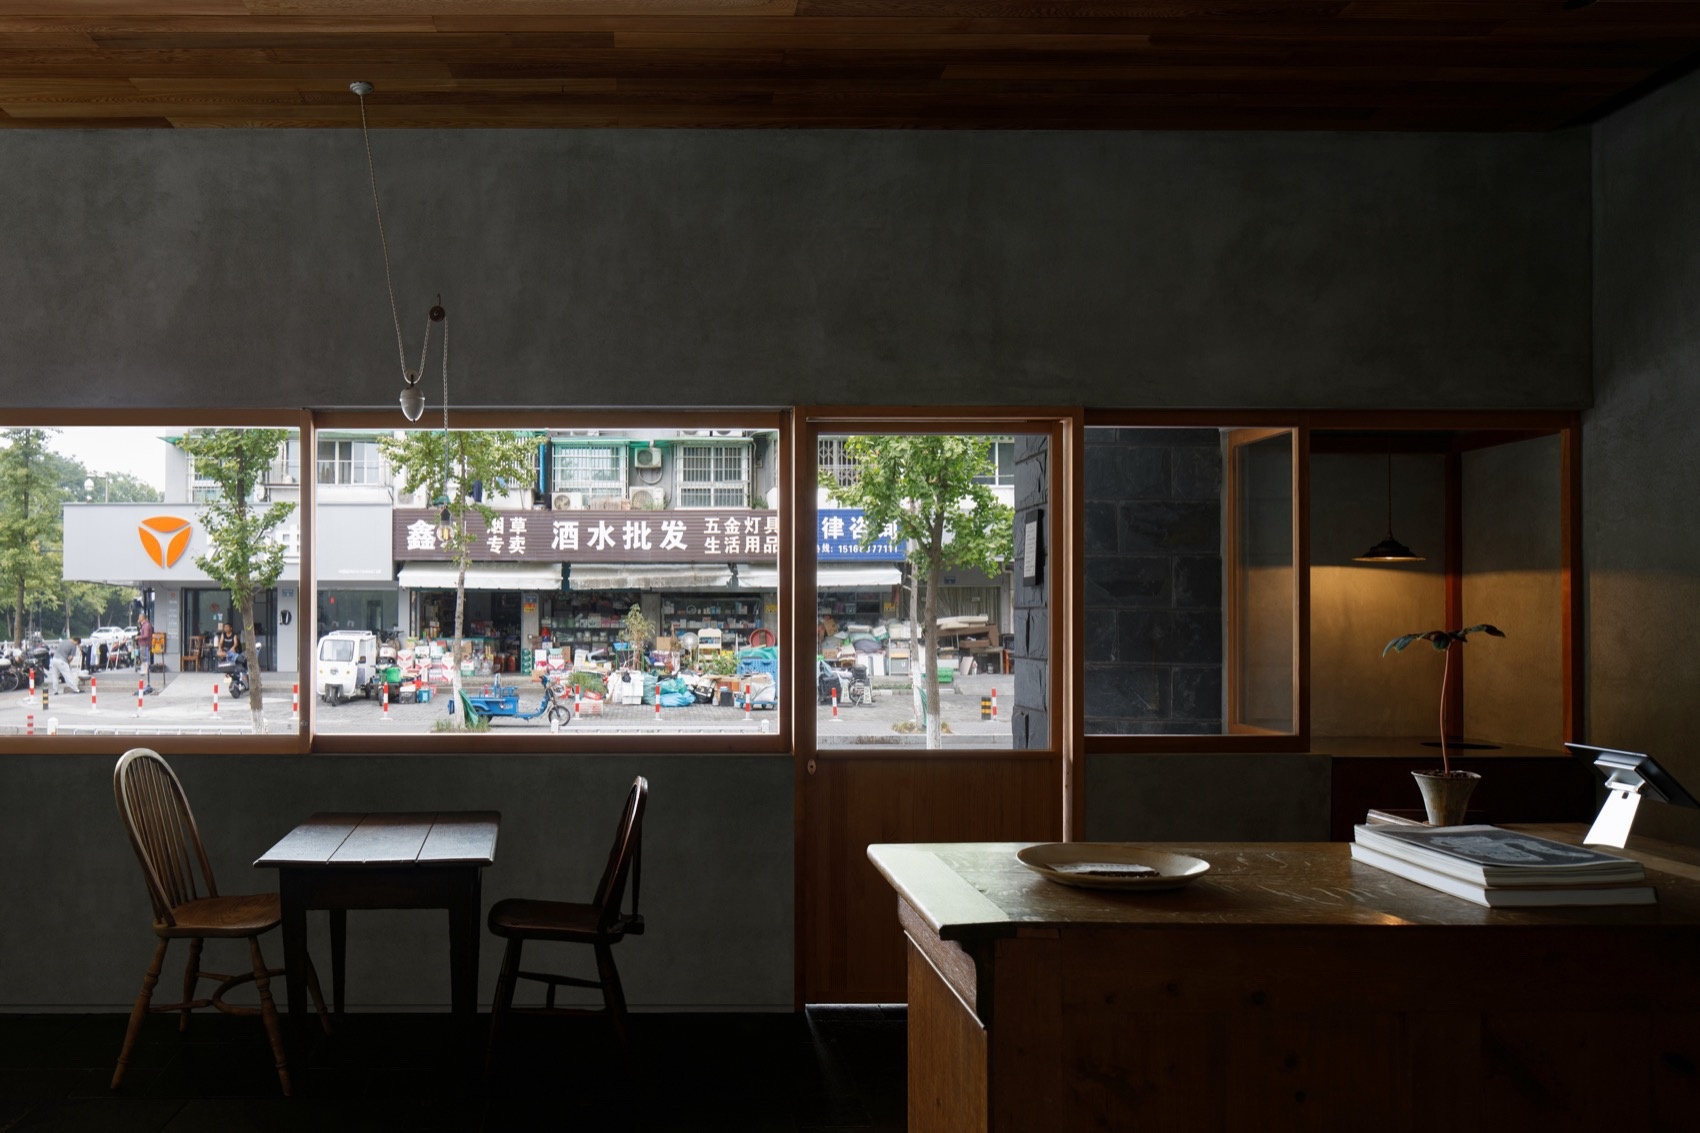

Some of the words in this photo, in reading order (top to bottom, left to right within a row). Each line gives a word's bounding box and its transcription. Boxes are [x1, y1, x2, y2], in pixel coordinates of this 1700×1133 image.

[703, 516, 778, 535] 五金灯具
[486, 535, 526, 554] 专卖
[551, 520, 688, 551] 酒水批发
[704, 536, 778, 554] 生活用品
